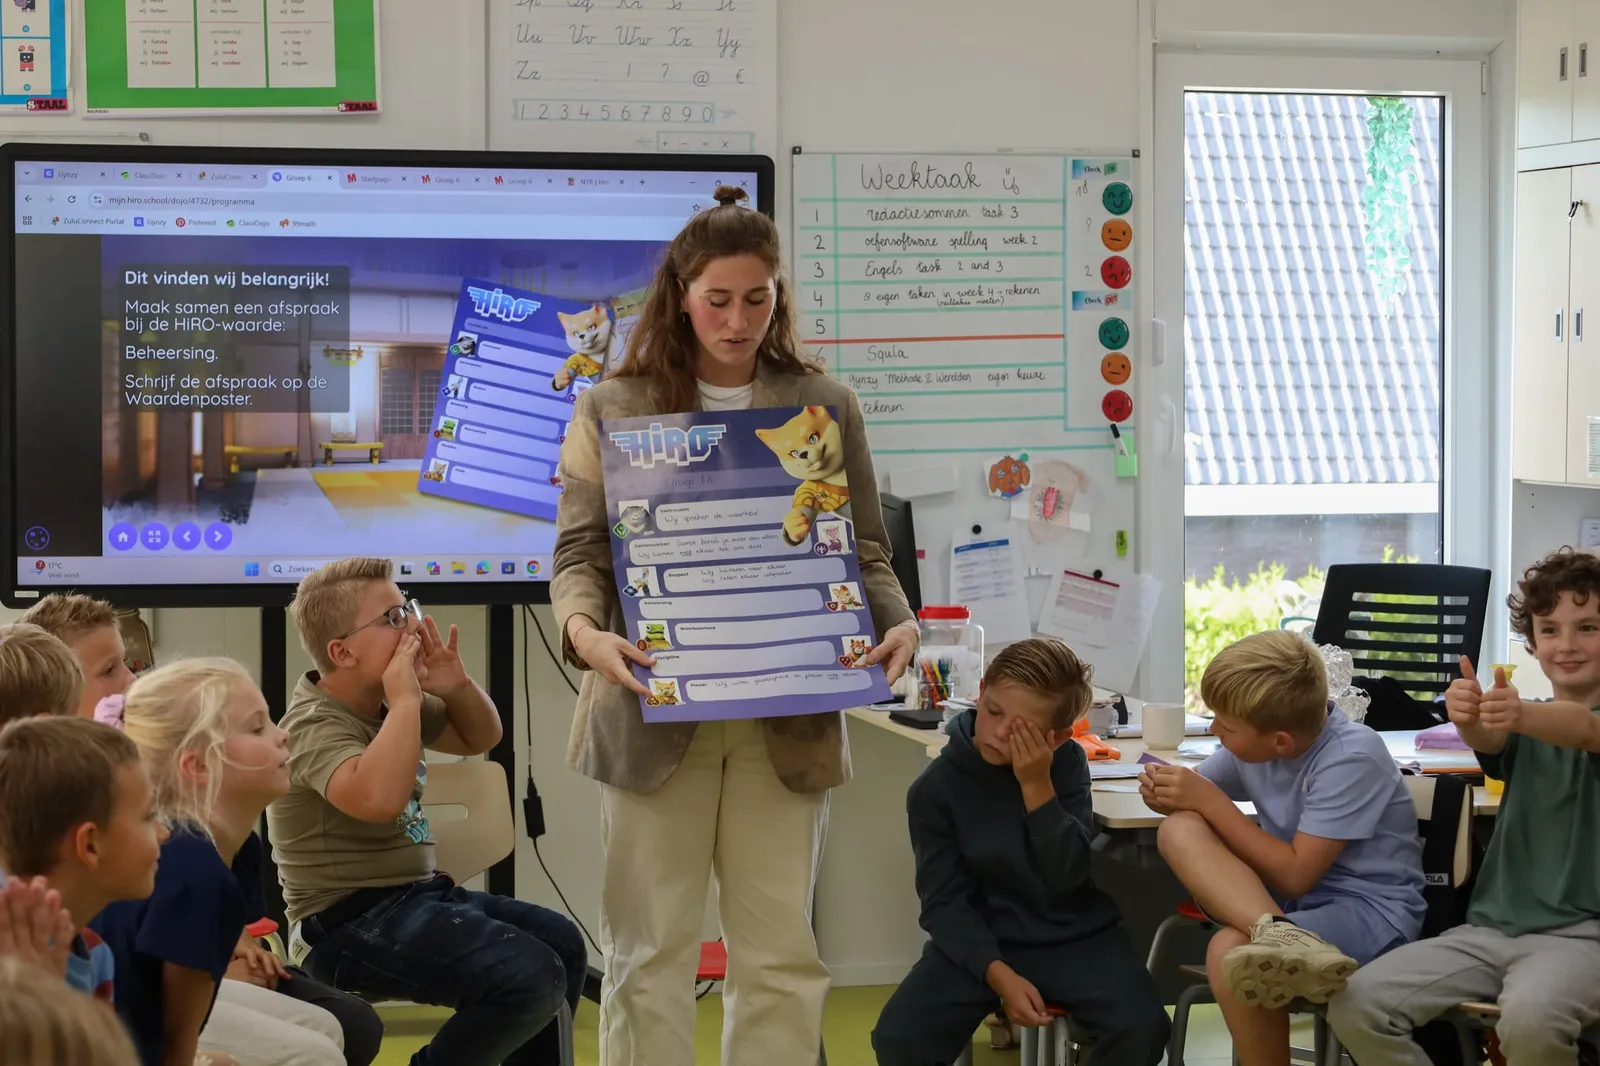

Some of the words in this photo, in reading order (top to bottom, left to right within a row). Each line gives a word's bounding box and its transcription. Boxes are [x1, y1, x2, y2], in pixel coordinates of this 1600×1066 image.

[516, 23, 543, 45] Uu
[568, 24, 597, 45] Vv
[615, 25, 653, 46] Ww
[668, 27, 692, 47] Xx
[716, 28, 741, 58] Yy
[516, 60, 542, 81] Zz
[693, 70, 710, 87] @
[735, 68, 745, 84] €
[27, 99, 66, 110] STAAL
[338, 102, 376, 112] STAAL
[538, 104, 549, 120] 2
[560, 104, 570, 120] 3
[579, 105, 590, 121] 4
[601, 105, 611, 121] 5
[621, 105, 631, 122] 6
[641, 105, 651, 122] 7
[662, 106, 672, 122] 8
[682, 106, 692, 122] 9
[702, 106, 713, 123] 0
[58, 171, 78, 180] Gynzy
[286, 174, 306, 183] Groep
[307, 174, 312, 182] 6
[861, 160, 981, 190] Weektaak
[109, 196, 255, 207] mijn.hiro.school/dojo/4732/programma
[63, 217, 104, 226] ZuluConnect
[106, 218, 125, 226] Portal
[867, 205, 971, 222] redactiesommen
[1010, 205, 1019, 219] 3
[147, 219, 167, 228] Gynzy
[188, 219, 217, 227] Pinterest
[238, 219, 270, 229] ClassDojo
[814, 234, 825, 250] 2
[864, 232, 939, 251] oefensoftware
[949, 231, 988, 251] spelling
[1002, 233, 1028, 245] week
[1031, 235, 1038, 246] 2
[813, 262, 824, 278] 3
[864, 259, 903, 279] Engels
[957, 261, 964, 271] 2
[970, 260, 990, 271] and
[995, 260, 1004, 273] 3
[1084, 264, 1093, 277] 2
[125, 271, 148, 285] Dit
[153, 271, 209, 286] vinden
[214, 271, 236, 289] wij
[241, 271, 329, 290] belangrijk!
[813, 290, 823, 308] 4
[876, 292, 900, 306] eigen
[908, 285, 936, 299] taken
[956, 285, 984, 298] week
[987, 287, 994, 297] 4
[1005, 283, 1041, 297] rekenen
[125, 300, 170, 314] Maak
[175, 303, 229, 314] samen
[234, 303, 263, 315] een
[268, 301, 340, 316] afspraak
[125, 317, 143, 334] bij
[149, 317, 169, 331] de
[174, 318, 287, 332] HiRO-waarde:
[815, 319, 826, 334] 5
[125, 346, 218, 363] Beheersing.
[867, 345, 909, 364] Squla
[125, 374, 175, 391] Schrijf
[180, 374, 201, 388] de
[205, 374, 277, 391] afspraak
[282, 378, 303, 392] op
[307, 376, 328, 389] de
[936, 371, 972, 384] Werelden
[988, 372, 1010, 387] eigen
[125, 391, 253, 408] Waardenposter.
[714, 512, 724, 520] de
[728, 510, 758, 519] waarheid
[63, 571, 80, 579] wind
